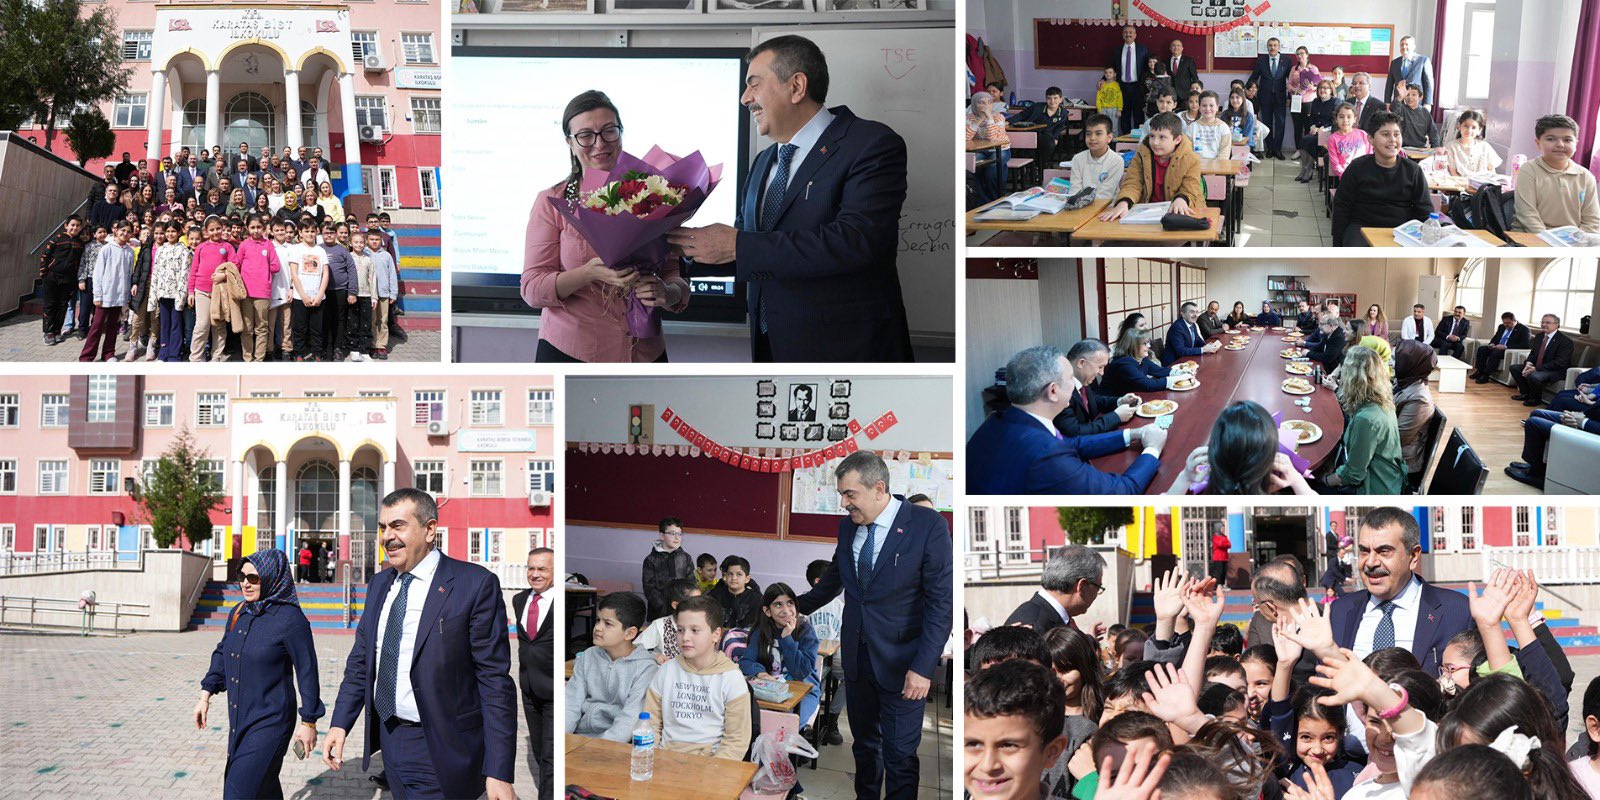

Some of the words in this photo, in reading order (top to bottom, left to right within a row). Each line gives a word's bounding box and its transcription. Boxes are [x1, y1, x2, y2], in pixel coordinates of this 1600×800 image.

[212, 20, 259, 30] KARATAŞ
[263, 18, 293, 30] BİST
[322, 411, 347, 422] BİST
[294, 422, 335, 431] İLKOKULU
[675, 682, 691, 691] NEW
[677, 692, 707, 702] LONDON
